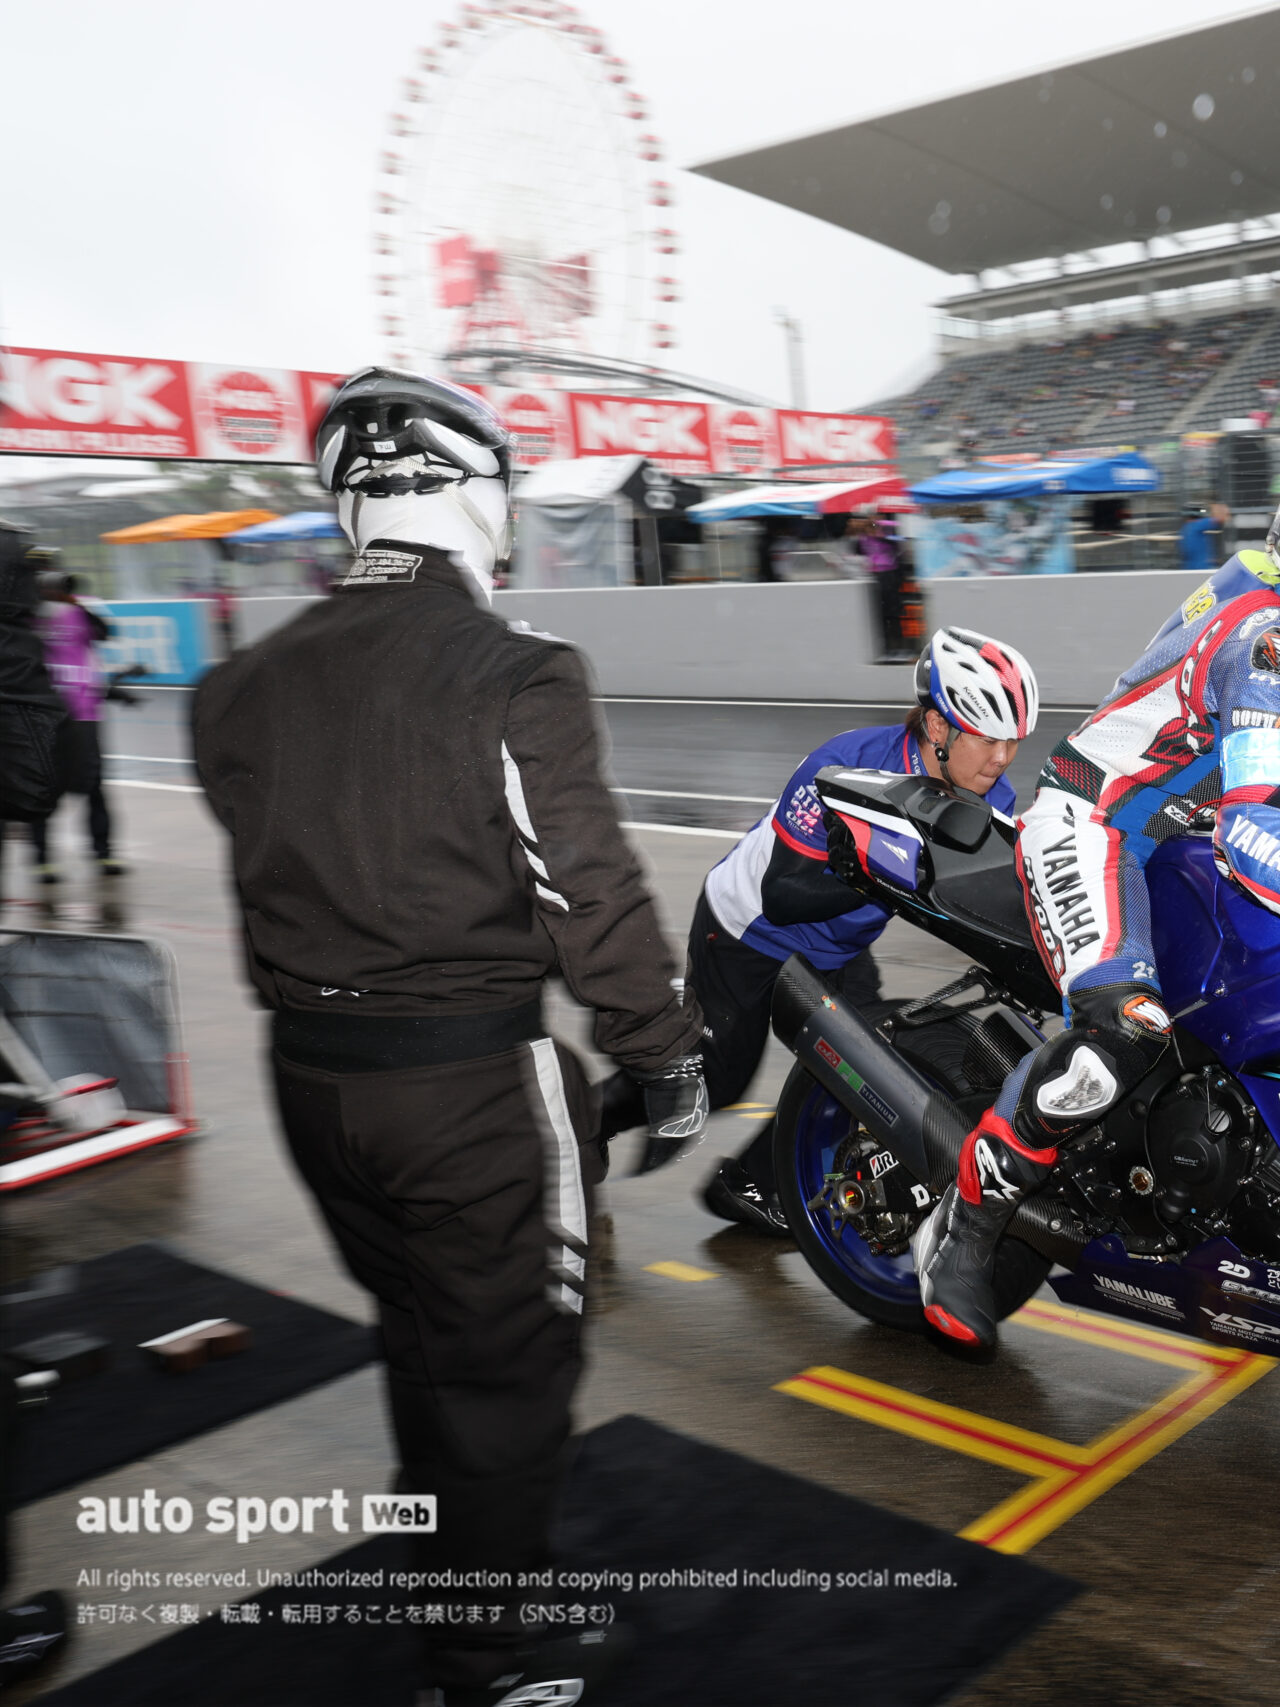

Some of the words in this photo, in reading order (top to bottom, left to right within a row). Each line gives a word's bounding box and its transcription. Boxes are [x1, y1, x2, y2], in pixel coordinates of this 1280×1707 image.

[575, 400, 708, 455] NGK
[781, 414, 888, 462] NGK
[1042, 833, 1100, 956] YAMAHA
[1217, 1260, 1251, 1279] 2D
[1093, 1273, 1177, 1310] YAMALUBE
[1209, 1320, 1238, 1333] YAMAHA
[1237, 1328, 1280, 1344] MOTORCYCLE
[1211, 1326, 1237, 1338] SPORTS
[1236, 1331, 1259, 1342] PLAZA
